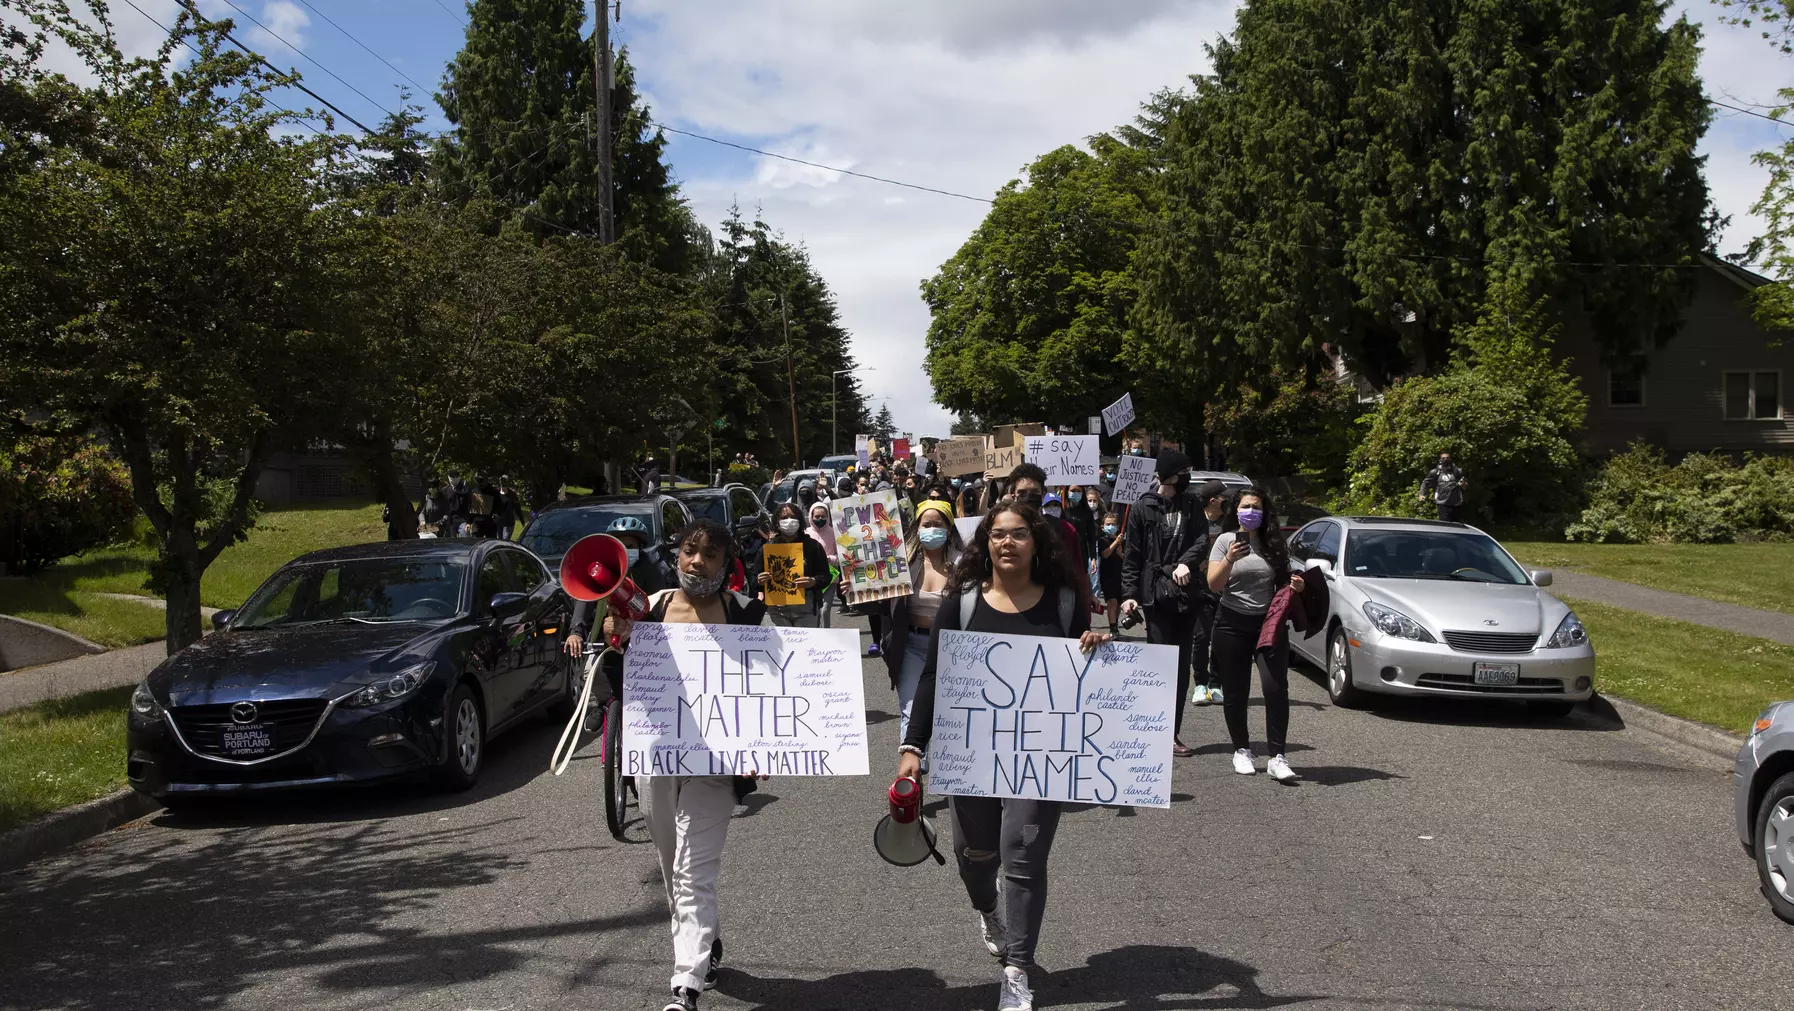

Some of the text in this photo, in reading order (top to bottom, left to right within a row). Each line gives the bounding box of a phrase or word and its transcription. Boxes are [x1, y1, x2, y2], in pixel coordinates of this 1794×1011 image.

[1105, 397, 1130, 419] VOTE
[1108, 414, 1122, 433] OUT
[951, 441, 964, 449] LIVES
[1051, 440, 1084, 463] say
[986, 451, 1013, 470] BLM
[1060, 456, 1095, 475] Names
[1130, 458, 1144, 470] NO
[1120, 469, 1149, 483] JUSTICE
[1125, 482, 1139, 491] NO
[843, 503, 886, 527] PWR
[861, 525, 873, 541] 2
[847, 541, 893, 561] THE
[730, 626, 773, 634] sandra
[635, 632, 673, 645] floyd
[941, 632, 994, 652] george
[627, 648, 673, 659] breonna
[1099, 643, 1143, 655] oscar
[628, 658, 662, 671] taylor
[688, 649, 795, 695] THEY
[938, 667, 988, 686] breonna
[981, 641, 1097, 713] SAY
[1130, 669, 1160, 679] eric
[624, 683, 667, 693] ahmaud
[1085, 687, 1139, 705] philando
[818, 712, 856, 721] michael
[934, 714, 965, 729] tamir
[1123, 711, 1166, 722] samuel
[825, 720, 852, 729] brown
[950, 706, 1103, 755] THEIR
[1128, 721, 1169, 731] dubose
[224, 731, 262, 741] SUBARU
[225, 739, 270, 749] PORTLAND
[652, 741, 688, 752] manuel
[1107, 738, 1151, 750] sandra
[932, 745, 976, 764] ahmaud
[628, 750, 693, 776] BLACK
[709, 750, 759, 776] LIVES
[1128, 763, 1164, 774] manuel
[929, 774, 967, 790] trayvon
[1123, 785, 1152, 796] david
